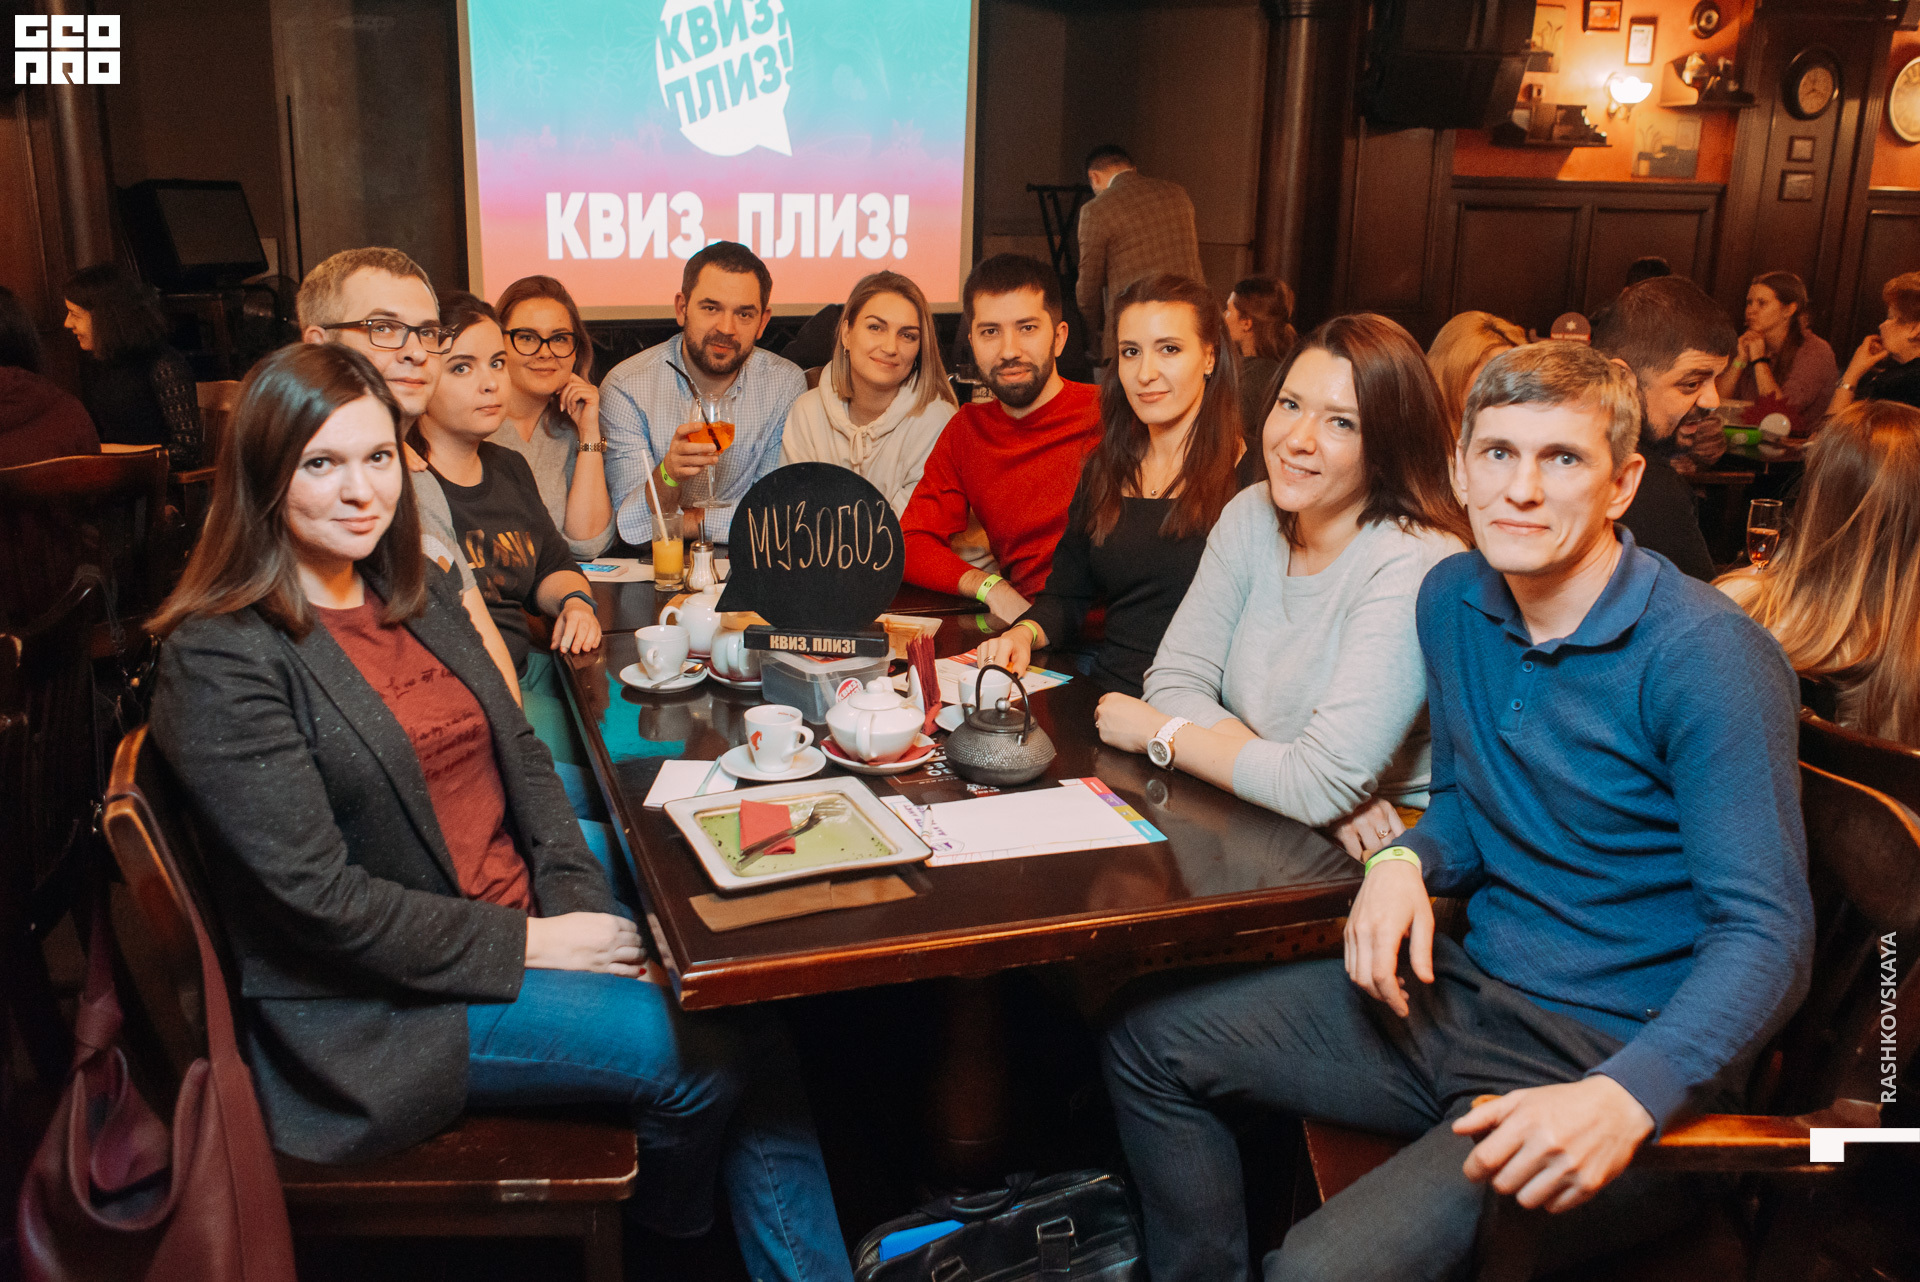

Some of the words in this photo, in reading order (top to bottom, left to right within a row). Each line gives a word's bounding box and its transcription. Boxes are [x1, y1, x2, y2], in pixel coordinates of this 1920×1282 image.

[664, 37, 794, 126] ПЛИЗ!
[738, 192, 909, 259] ПЛИЗ!
[748, 499, 894, 571] МУЗОБОЗ
[770, 635, 810, 653] КВИЗ,
[812, 637, 856, 653] ПЛИЗ!
